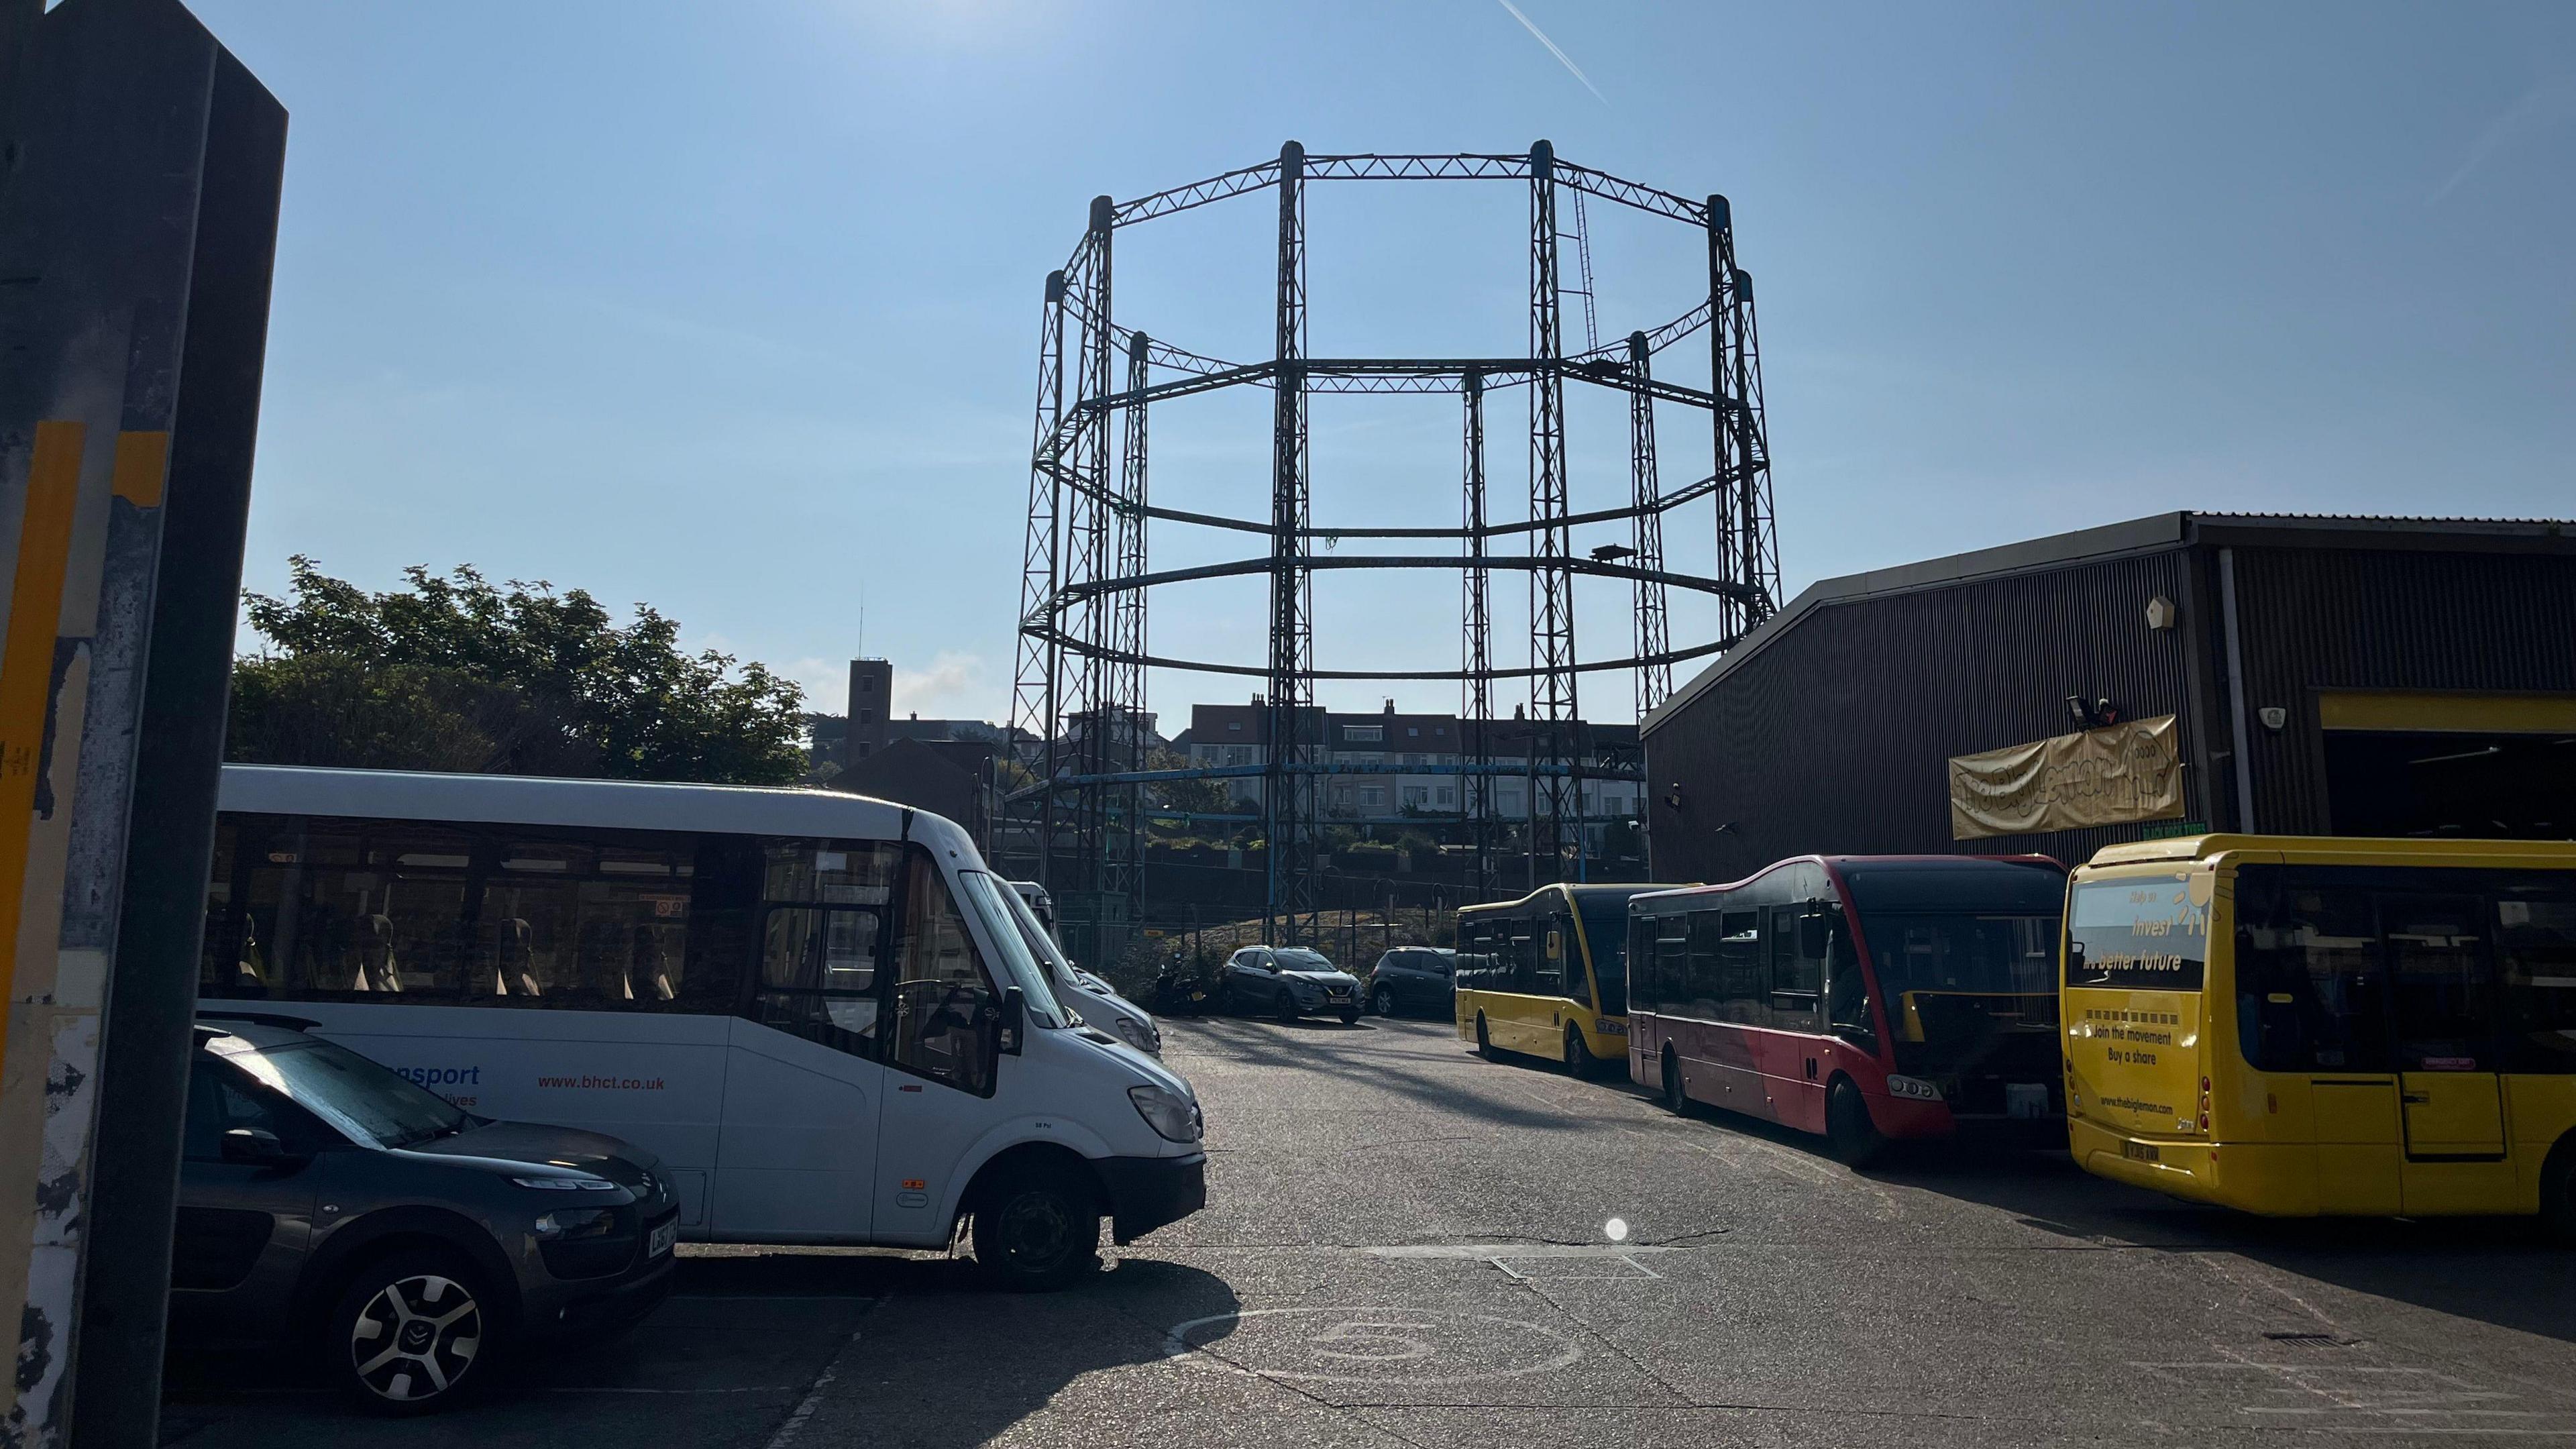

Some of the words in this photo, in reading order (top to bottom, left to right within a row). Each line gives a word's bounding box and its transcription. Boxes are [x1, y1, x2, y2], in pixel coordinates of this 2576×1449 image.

[2129, 891, 2147, 905] Help
[2132, 915, 2174, 936] invest
[2098, 950, 2137, 971] better
[2139, 949, 2182, 971] future
[2093, 1024, 2110, 1039] Join
[2112, 1025, 2125, 1040] the
[2127, 1030, 2171, 1045] movement
[2108, 1047, 2123, 1065] Buy
[2125, 1051, 2131, 1063] a
[2133, 1049, 2157, 1065] share
[539, 1075, 664, 1090] www.bhct.co.uk
[2100, 1096, 2174, 1115] www.thebiglemon.com
